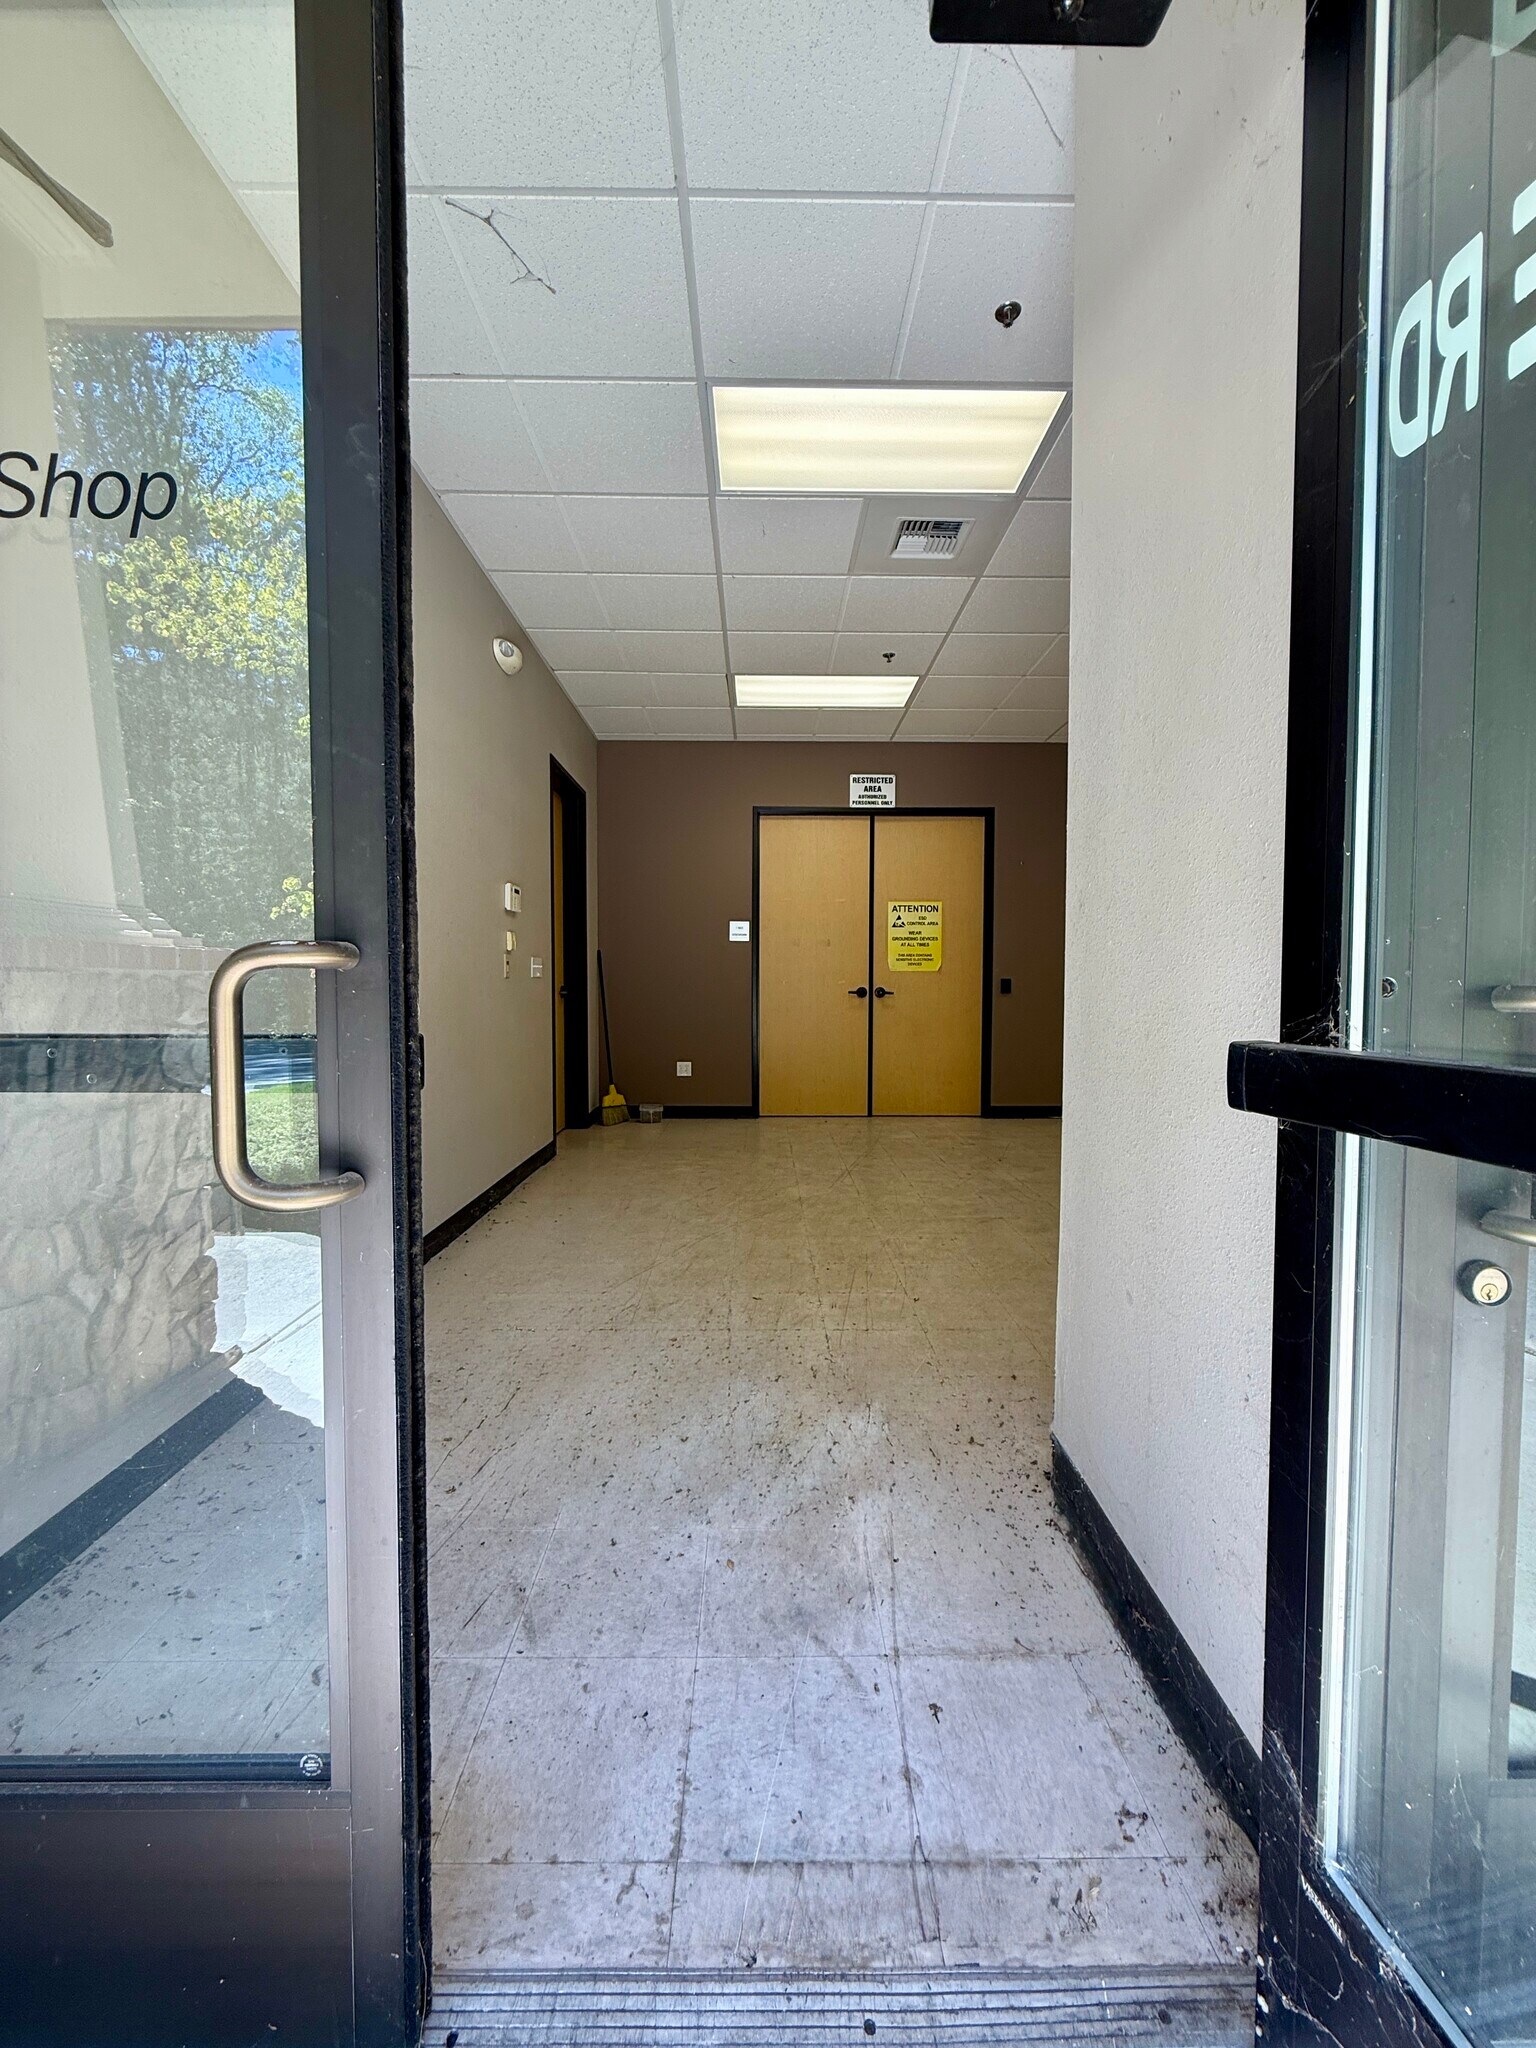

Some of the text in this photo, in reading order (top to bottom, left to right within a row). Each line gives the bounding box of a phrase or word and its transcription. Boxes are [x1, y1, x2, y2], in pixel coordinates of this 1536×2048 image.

[0, 451, 178, 539] Shop
[892, 904, 939, 913] ATTENTION
[1300, 1872, 1346, 1947] VISTAWALL
